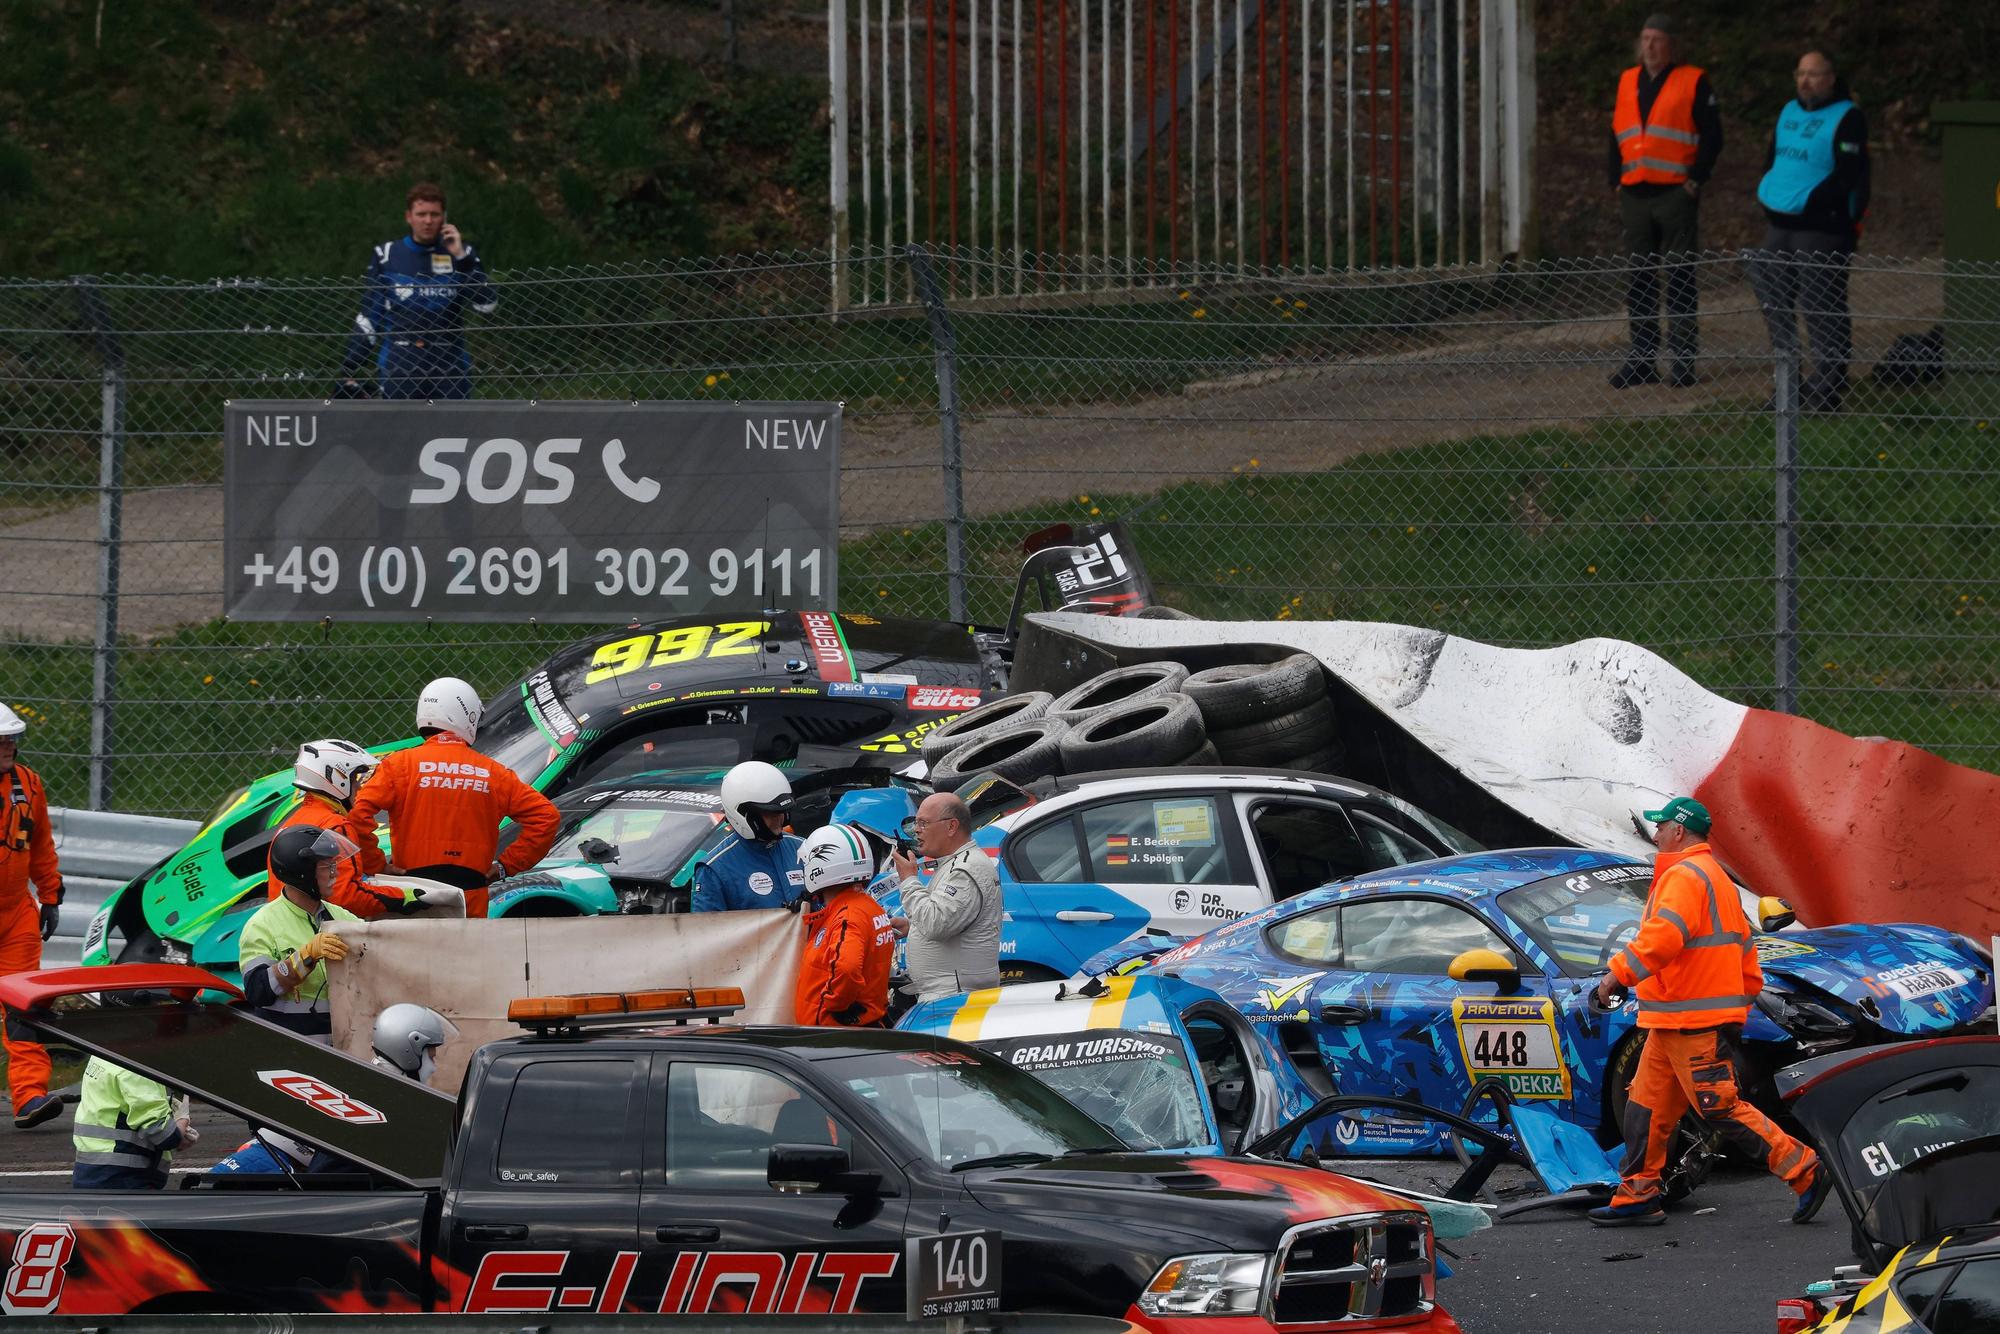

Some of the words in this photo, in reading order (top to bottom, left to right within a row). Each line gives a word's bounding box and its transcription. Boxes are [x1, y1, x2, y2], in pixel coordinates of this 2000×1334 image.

[246, 416, 318, 446] NEU
[745, 420, 826, 450] NEW
[409, 438, 582, 504] SOS
[243, 547, 340, 594] +49
[359, 546, 427, 607] (0)
[446, 547, 568, 595] 2691
[595, 548, 689, 596] 302
[709, 548, 821, 596] 9111
[1055, 568, 1080, 592] YEARS
[805, 614, 844, 664] WEMPE
[585, 621, 771, 685] 992
[912, 694, 982, 707] auto
[917, 688, 953, 697] sport
[541, 698, 577, 736] TURISMO
[418, 761, 490, 778] DMSB
[419, 776, 490, 793] STAFFEL
[1131, 837, 1141, 846] E.
[1144, 837, 1181, 846] Becker
[1130, 853, 1140, 862] J.
[1143, 853, 1184, 864] Spölgen
[180, 862, 207, 902] eFuels
[1592, 867, 1630, 881] GRAN
[1201, 893, 1224, 907] DR.
[1201, 904, 1250, 920] WORK
[1877, 961, 1946, 981] overtake
[1899, 974, 1937, 994] H&R
[1467, 1005, 1537, 1015] RAVENOL
[1012, 1043, 1071, 1065] GRAN
[1076, 1037, 1166, 1060] TURISMO
[1474, 1030, 1528, 1067] 448
[1616, 1031, 1645, 1075] EAGLE
[1035, 1062, 1060, 1070] REAL
[1062, 1057, 1101, 1067] DRIVING
[1104, 1051, 1162, 1062] SIMULATOR
[1509, 1075, 1564, 1094] DEKRA
[1861, 1141, 1900, 1177] 13
[2, 1222, 78, 1315] 8
[933, 1236, 988, 1291] 140
[923, 1303, 938, 1316] SOS
[940, 1302, 953, 1313] +49
[954, 1300, 969, 1313] 2691
[971, 1299, 984, 1311] 302
[986, 1297, 999, 1309] 9111
